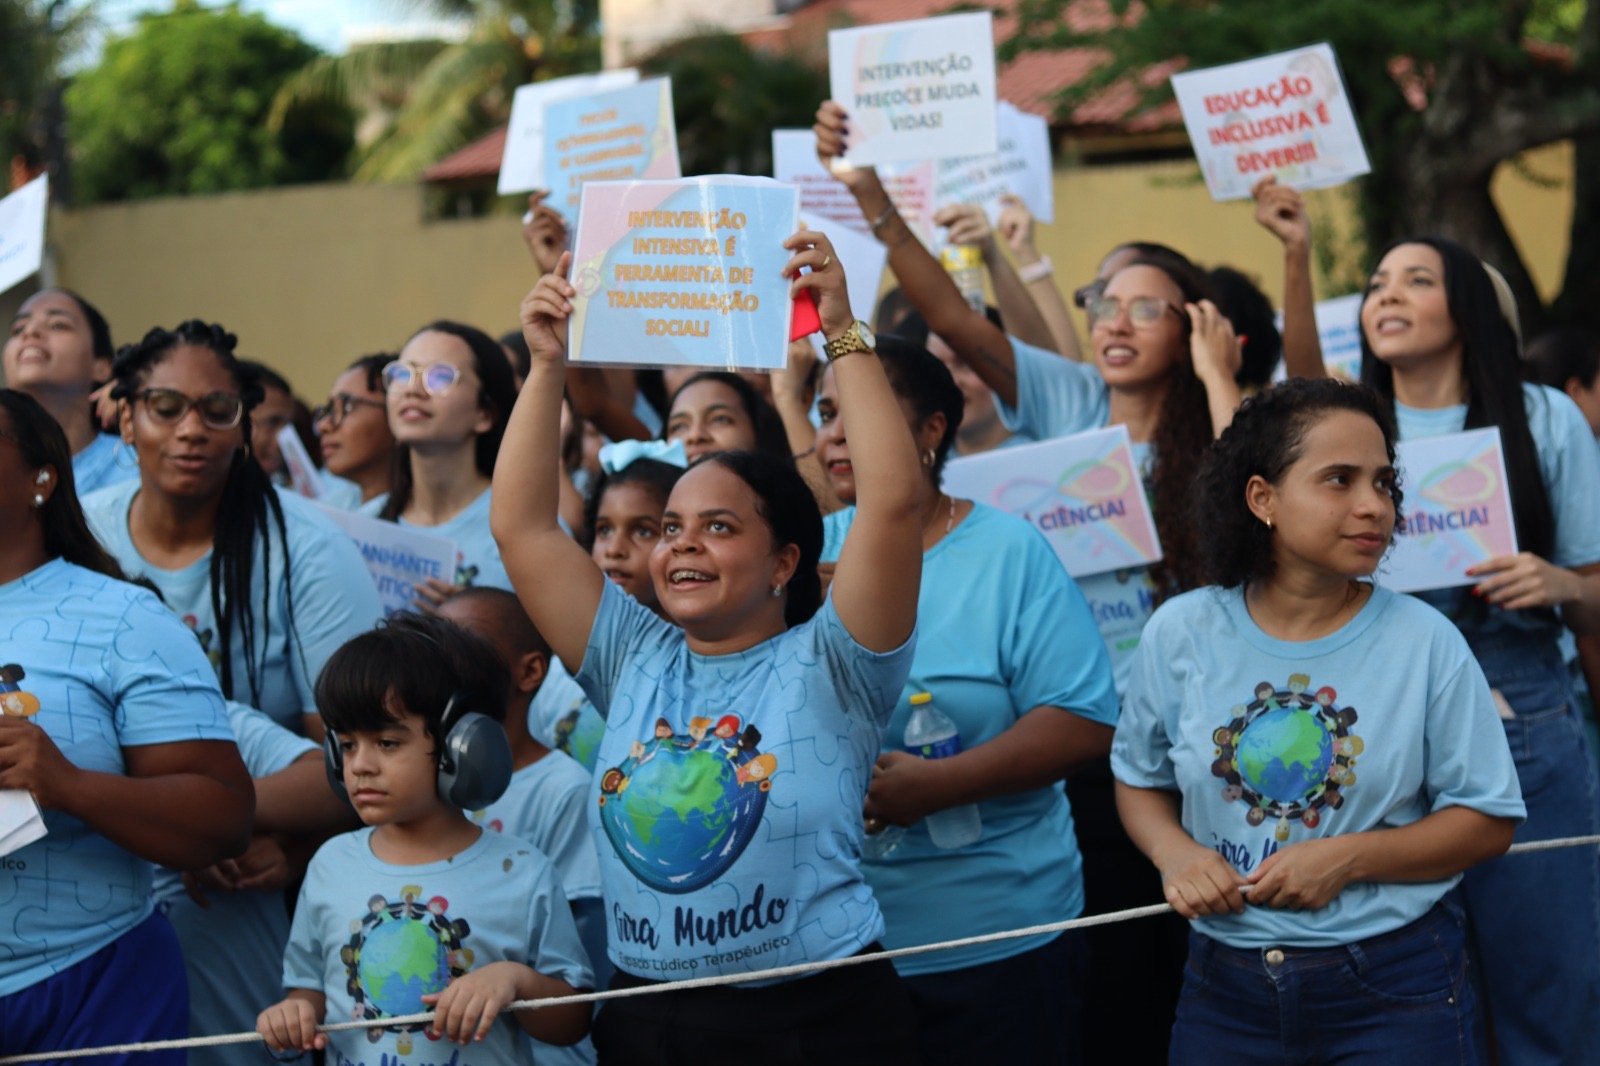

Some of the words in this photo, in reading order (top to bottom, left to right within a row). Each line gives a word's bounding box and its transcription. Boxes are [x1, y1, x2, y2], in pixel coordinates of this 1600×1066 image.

[858, 52, 972, 81] INTERVENÇÃO
[927, 81, 981, 101] MUDA
[1203, 75, 1313, 115] EDUCAÇÃO
[1208, 110, 1312, 147] INCLUSIVA
[628, 208, 747, 232] INTERVENÇÃO
[633, 237, 721, 256] INTENSIVA
[725, 235, 737, 256] É
[615, 264, 724, 284] FERRAMENTA
[729, 267, 754, 284] DE
[607, 290, 760, 315] TRANSFORMAÇÃO
[645, 319, 710, 337] SOCIAL!
[1039, 499, 1126, 531] CIÊNCIA!
[614, 902, 660, 951] Gira
[675, 883, 789, 947] Mundo
[653, 957, 698, 971] Lúdico
[703, 935, 790, 967] Terapêutico
